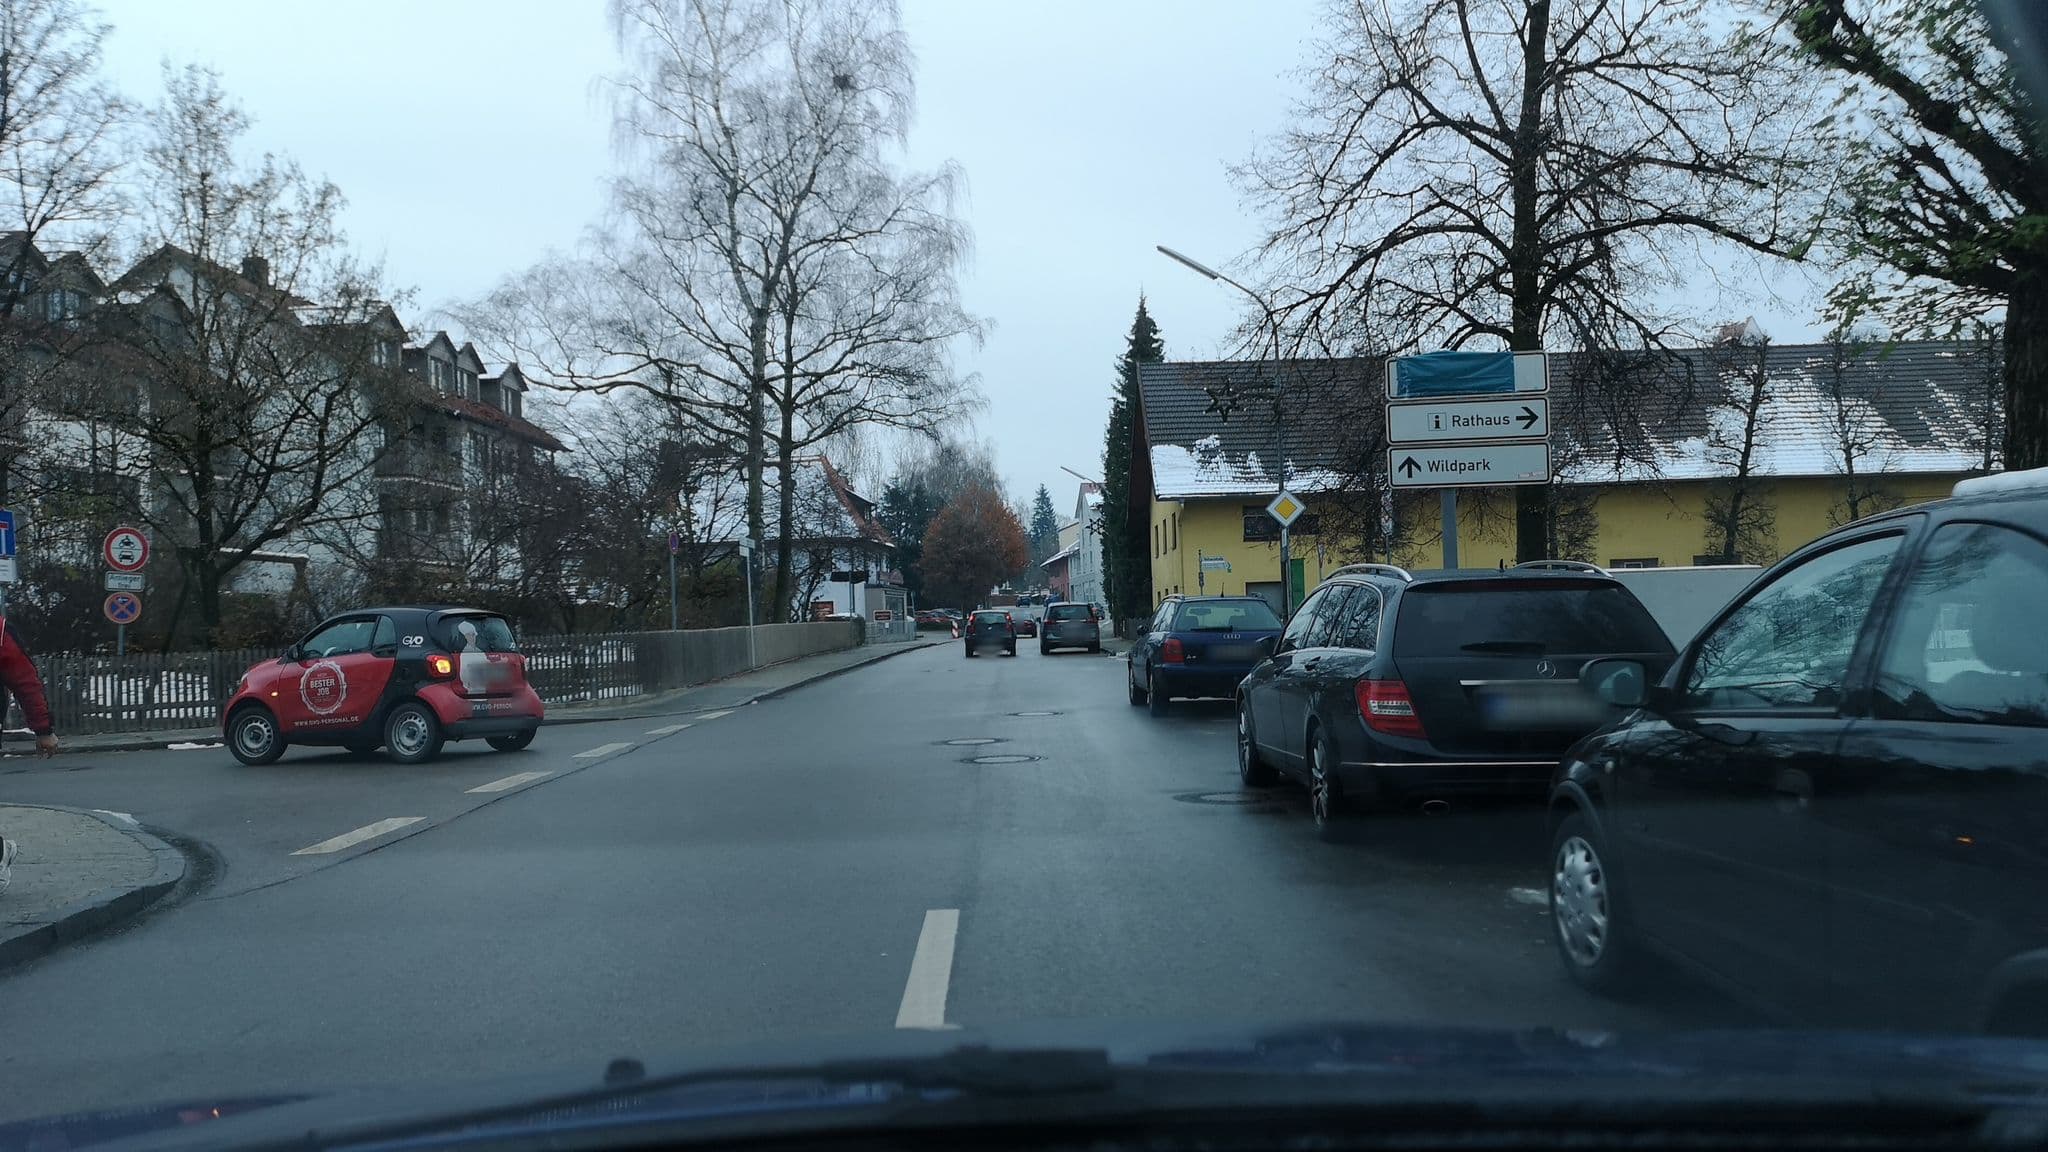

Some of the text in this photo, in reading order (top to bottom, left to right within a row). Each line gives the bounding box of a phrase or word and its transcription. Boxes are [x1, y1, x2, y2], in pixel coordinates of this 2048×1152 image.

[1452, 414, 1511, 427] Rathaus
[1427, 459, 1491, 474] Wildpark
[310, 678, 335, 689] BESTER
[317, 688, 330, 696] JOB
